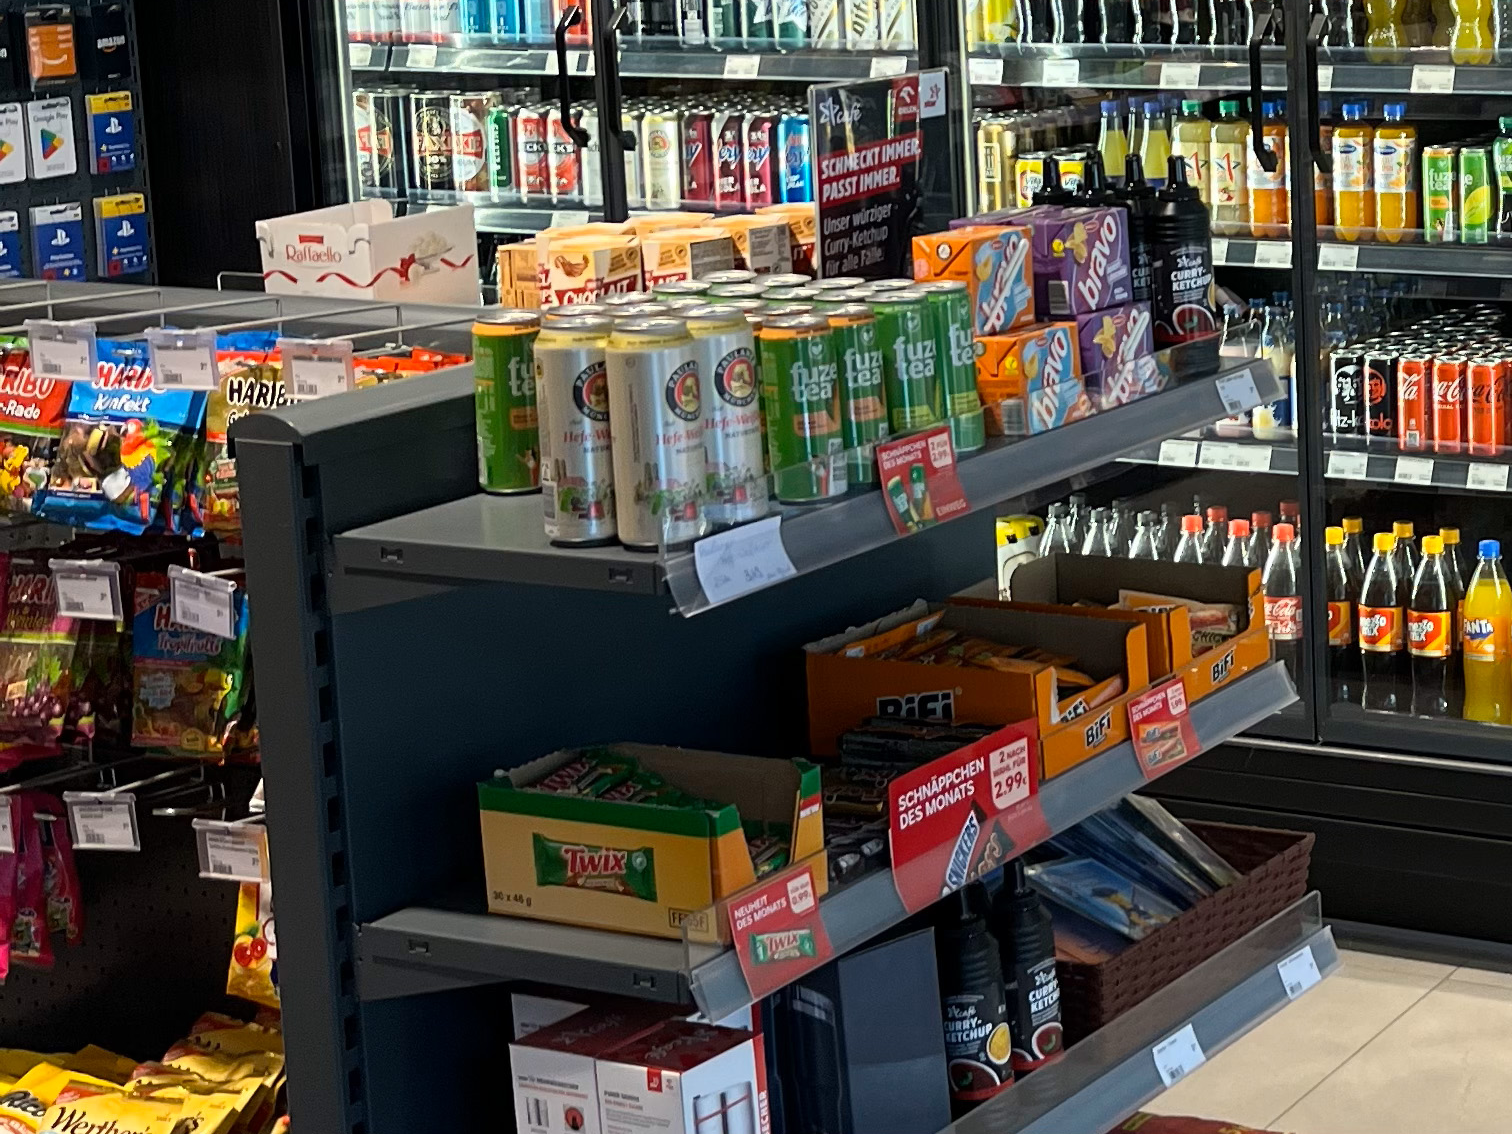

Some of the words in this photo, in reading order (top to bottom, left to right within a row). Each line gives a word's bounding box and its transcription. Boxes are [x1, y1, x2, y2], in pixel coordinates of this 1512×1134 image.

[821, 147, 880, 180] SCHMECKT
[882, 137, 922, 163] IMMER.
[822, 176, 857, 203] PASST
[859, 166, 900, 193] IMMER.
[823, 216, 850, 236] Unser
[852, 202, 893, 228] würziger
[286, 243, 342, 264] Raffaello
[824, 225, 889, 257] Curry-Ketchup
[826, 259, 840, 278] für
[1078, 215, 1117, 309] bravo
[1171, 265, 1207, 282] CURRY-
[950, 324, 973, 348] fu
[845, 347, 884, 374] fuz
[898, 359, 935, 380] tea
[791, 361, 838, 388] fuze
[1033, 329, 1068, 429] bravo
[226, 376, 304, 409] HARIB
[793, 377, 834, 403] tea
[0, 398, 40, 420] -Rado
[1463, 618, 1494, 636] FANTA
[1210, 647, 1236, 684] BiFi
[1083, 707, 1114, 747] BiFi
[999, 749, 1006, 764] 2
[898, 756, 985, 812] SCHNÄPPCHEN
[899, 806, 923, 831] DES
[925, 780, 975, 817] MONATS
[736, 916, 753, 931] DES
[1030, 990, 1060, 1015] KETCH
[0, 1089, 46, 1118] Rico
